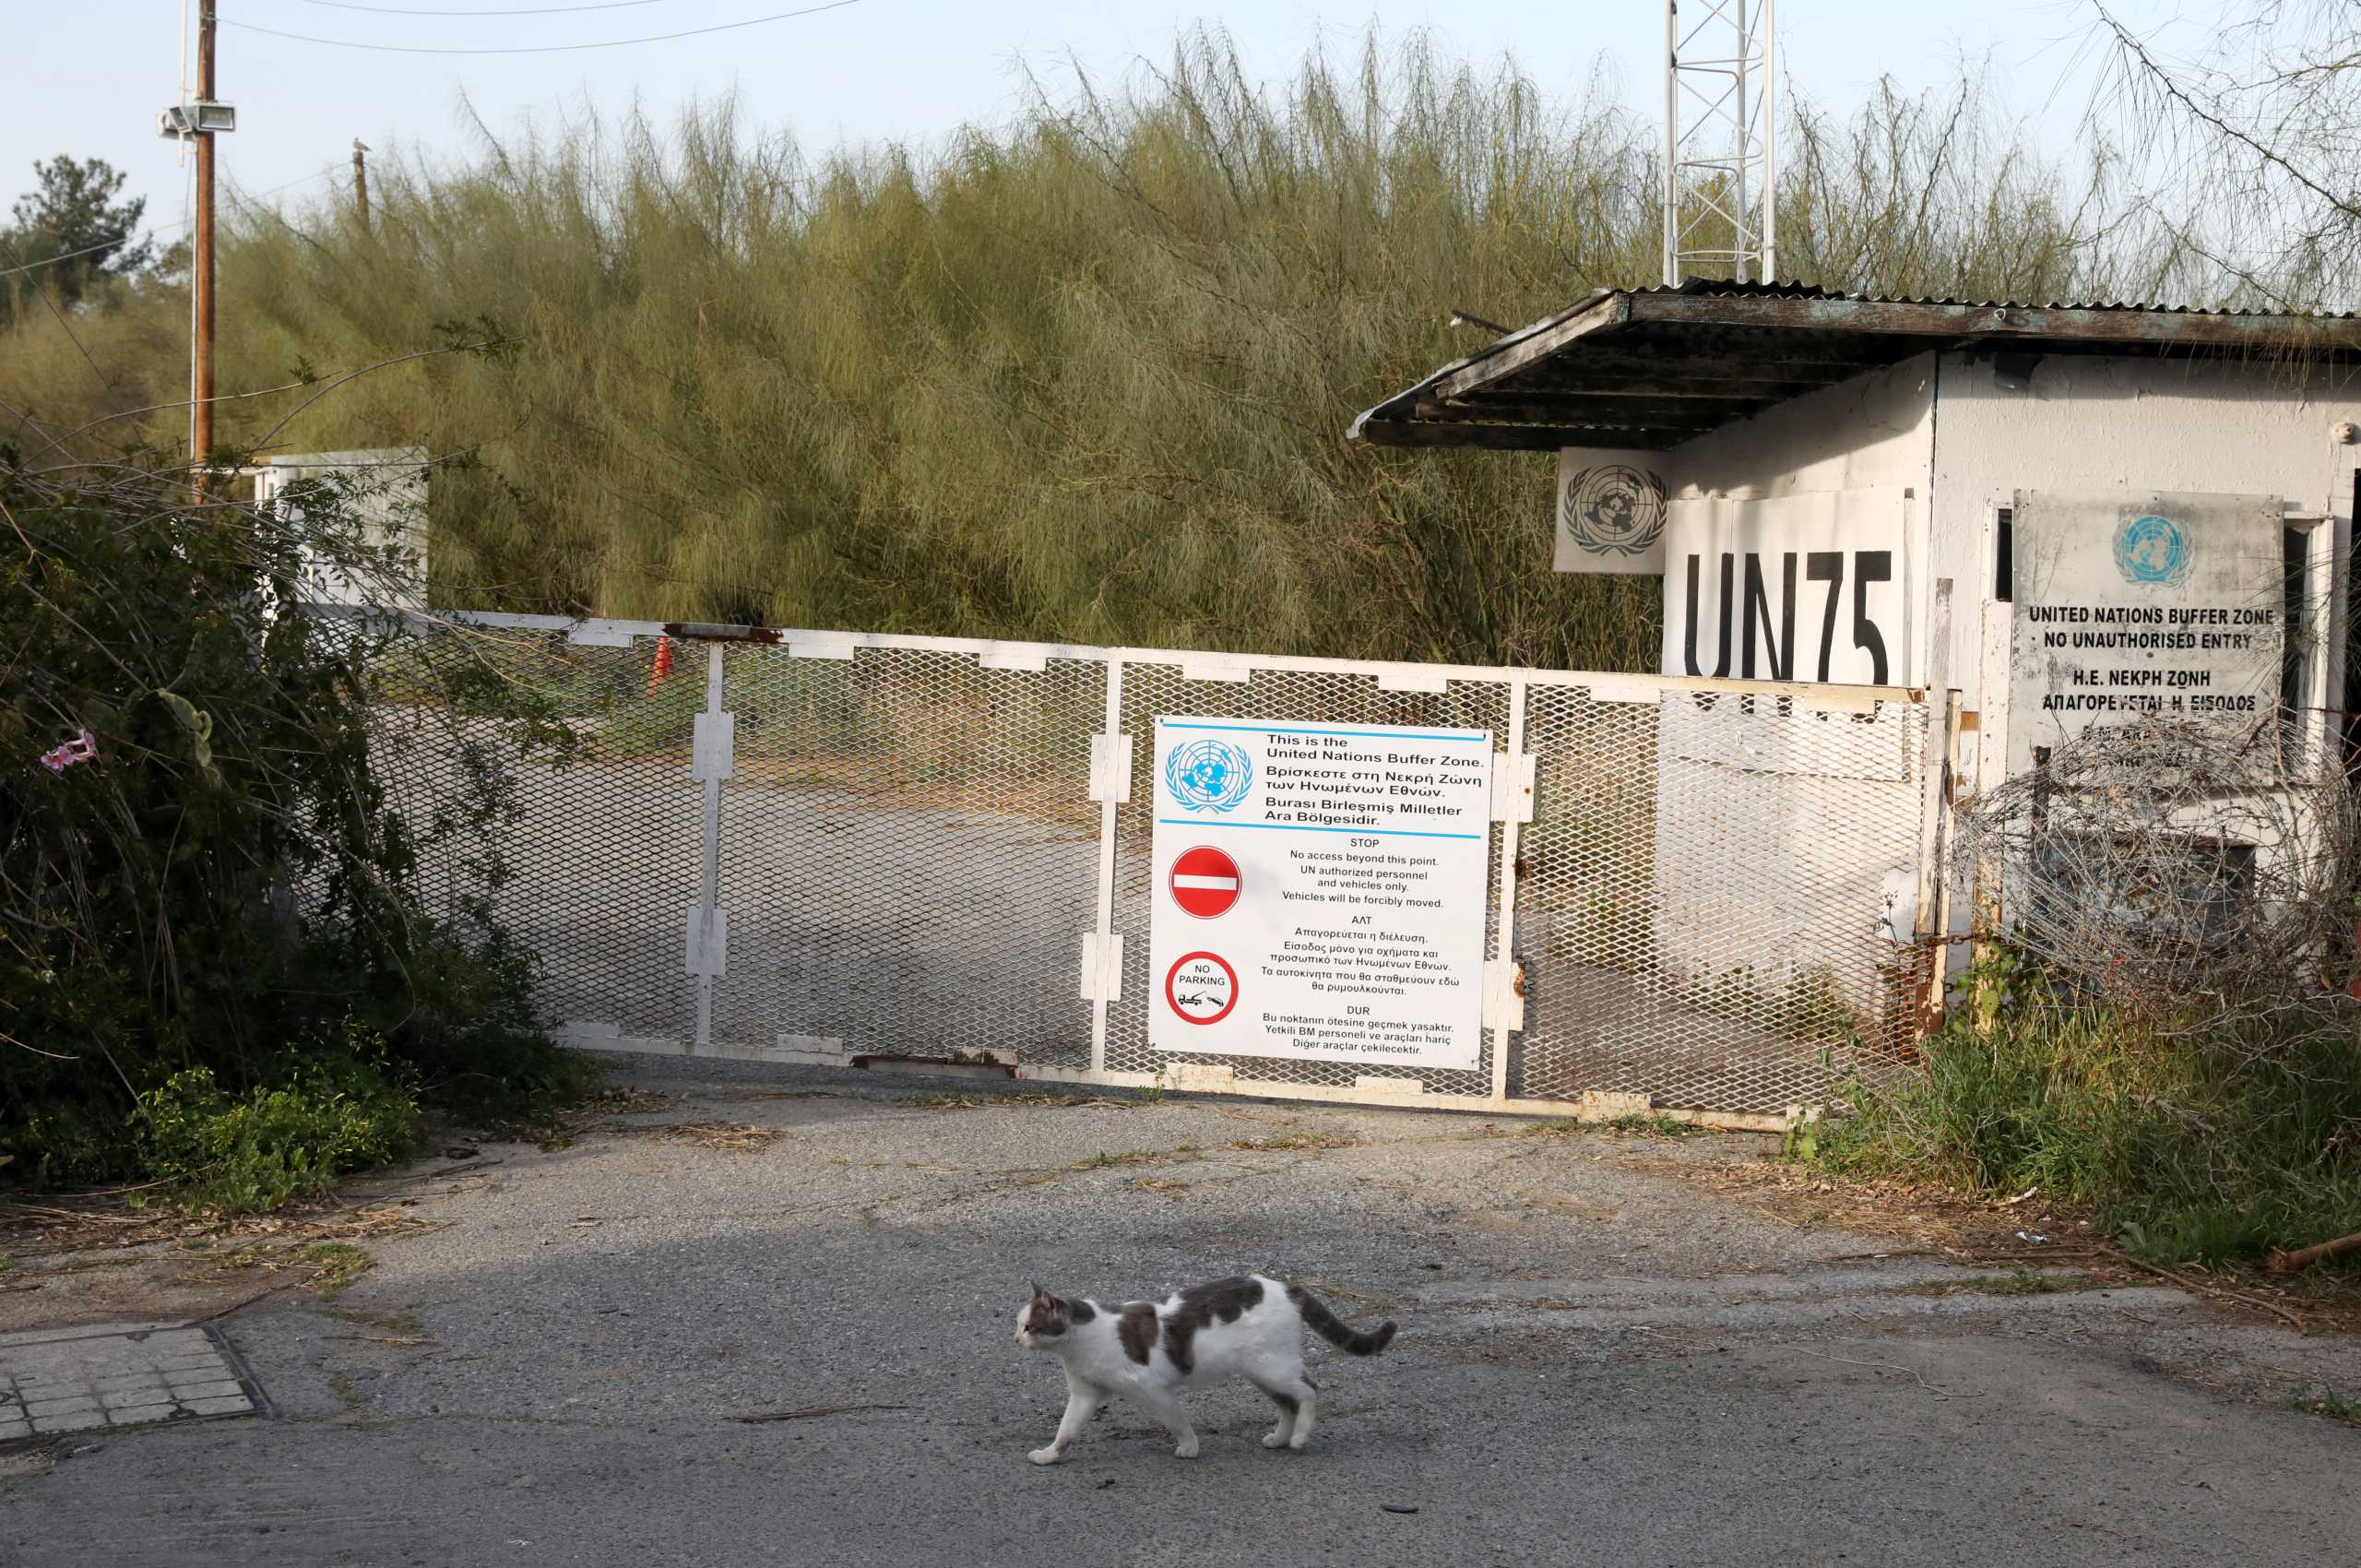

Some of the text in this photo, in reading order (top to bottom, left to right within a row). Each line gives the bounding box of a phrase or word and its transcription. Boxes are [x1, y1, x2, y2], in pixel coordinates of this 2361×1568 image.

[2029, 606, 2273, 625] UNITED NATIONS BUFFER ZONE
[2044, 632, 2252, 649] NO UNAUTHORISED ENTRY
[2108, 670, 2162, 686] ΝΕΚΡΗ
[1266, 734, 1347, 747] This is the
[1267, 747, 1483, 767] United Nations Buffer Zone.
[1266, 766, 1481, 788] Βρίσκεστε στη Νεκρή Ζώνη
[1265, 780, 1444, 797] των Ηνωμένων Εθνών.
[1265, 796, 1462, 815] Burası Birleşmiş Milletler
[1264, 810, 1380, 826] Ara Bölgesidir.
[1350, 837, 1380, 848] STOP
[1290, 849, 1439, 866] No access beyond this point.
[1300, 864, 1428, 880] UN authorized personnel
[1317, 878, 1409, 893] and vehicles only.
[1282, 890, 1443, 908] Vehicles will be forcibly moved.
[1351, 915, 1372, 924] ΑΛΤ
[1294, 927, 1428, 944] Απαγορεύεται η διέλευση.
[1284, 941, 1326, 954] Είσοδος
[1329, 945, 1355, 954] μόνο
[1358, 947, 1373, 956] για
[1376, 946, 1419, 958] οχήματα
[1194, 965, 1210, 973] NO
[1270, 954, 1451, 970] προσωπικό των Ηνωμένων Εθνών.
[1179, 975, 1225, 986] PARKING
[1261, 966, 1459, 986] Τα αυτοκίνητα που θα σταθμεύουν εδώ
[1311, 980, 1406, 995] θα ρυμουλκούνται.
[1347, 1005, 1370, 1016] DUR
[1263, 1012, 1453, 1032] Bu noktanın ötesine geçmek yasaktır.
[1264, 1025, 1451, 1046] Yetkili BM personeli ve araçları hariç
[1323, 1041, 1358, 1051] araçlar
[1360, 1043, 1421, 1054] çekilecektir.
